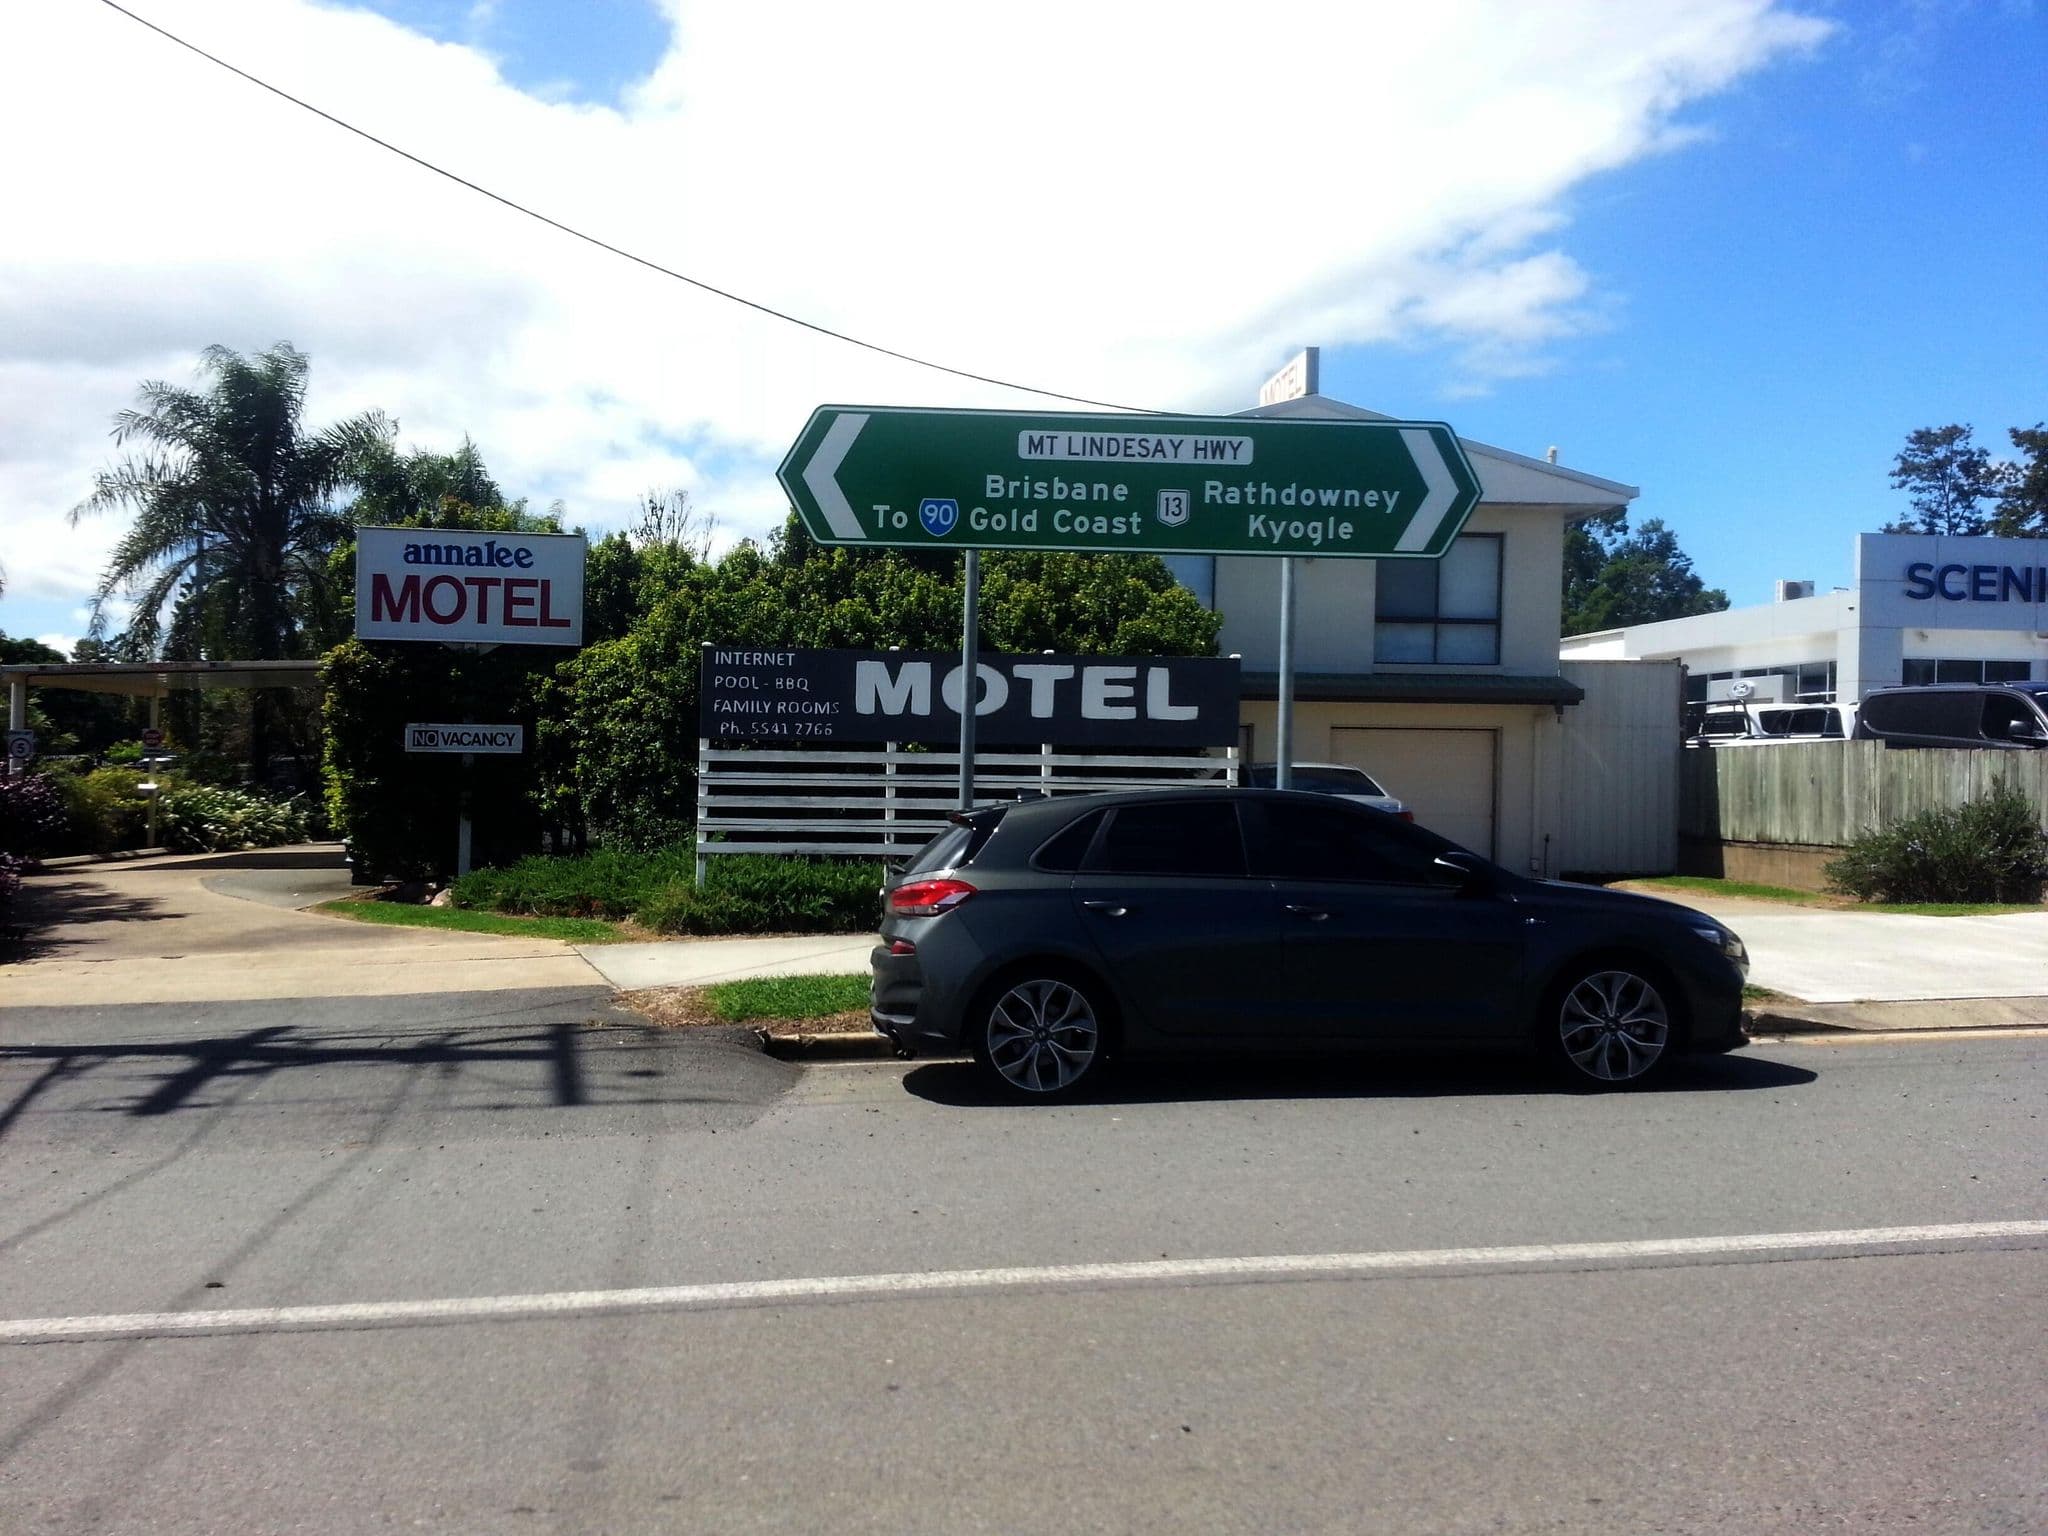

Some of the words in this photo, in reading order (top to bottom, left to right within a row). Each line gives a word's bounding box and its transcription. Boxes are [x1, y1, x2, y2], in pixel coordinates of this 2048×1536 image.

[1028, 435, 1058, 456] MT
[1067, 436, 1185, 460] LINDESAY
[1193, 440, 1243, 460] HWY
[985, 474, 1129, 501] Brisbane
[1203, 480, 1400, 514] Rathdowney
[872, 505, 908, 529] To
[924, 504, 954, 526] 90
[1164, 497, 1182, 517] 13
[969, 507, 1038, 532] Gold
[1053, 509, 1142, 535] Coast
[1248, 514, 1354, 546] Kyogle
[403, 540, 534, 568] annalee
[1905, 562, 2046, 603] SCENI
[371, 573, 571, 628] MOTEL
[714, 651, 796, 666] INTERNET
[714, 675, 760, 690] POOL
[775, 677, 810, 692] BBQ
[855, 661, 1199, 720] MOTEL
[713, 699, 772, 714] FAMILY
[777, 701, 840, 715] ROOMS
[414, 731, 438, 747] NO
[440, 732, 516, 747] VACANCY
[720, 721, 745, 735] Ph.
[750, 722, 789, 736] 5541
[794, 722, 833, 736] 2766
